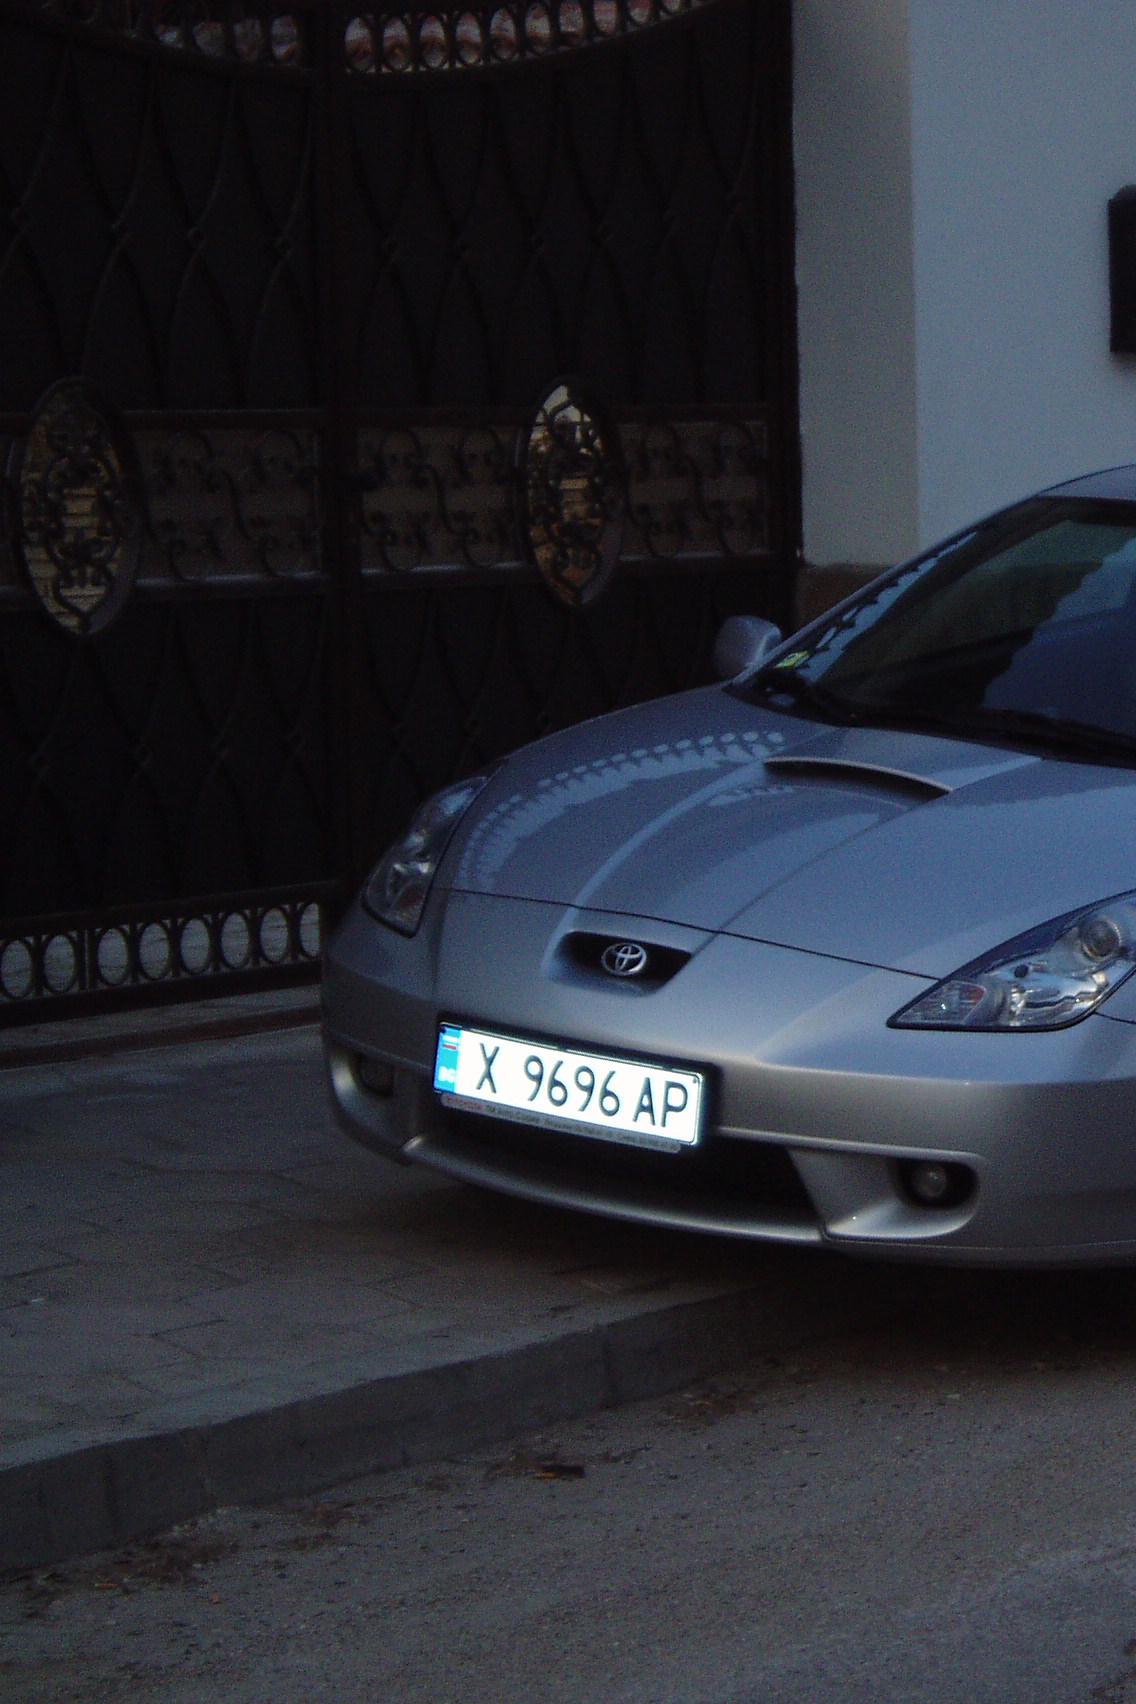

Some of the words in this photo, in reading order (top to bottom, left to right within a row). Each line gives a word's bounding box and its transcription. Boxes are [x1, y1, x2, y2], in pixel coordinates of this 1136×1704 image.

[476, 1043, 500, 1094] X
[524, 1054, 620, 1117] 9696
[632, 1076, 689, 1128] AP
